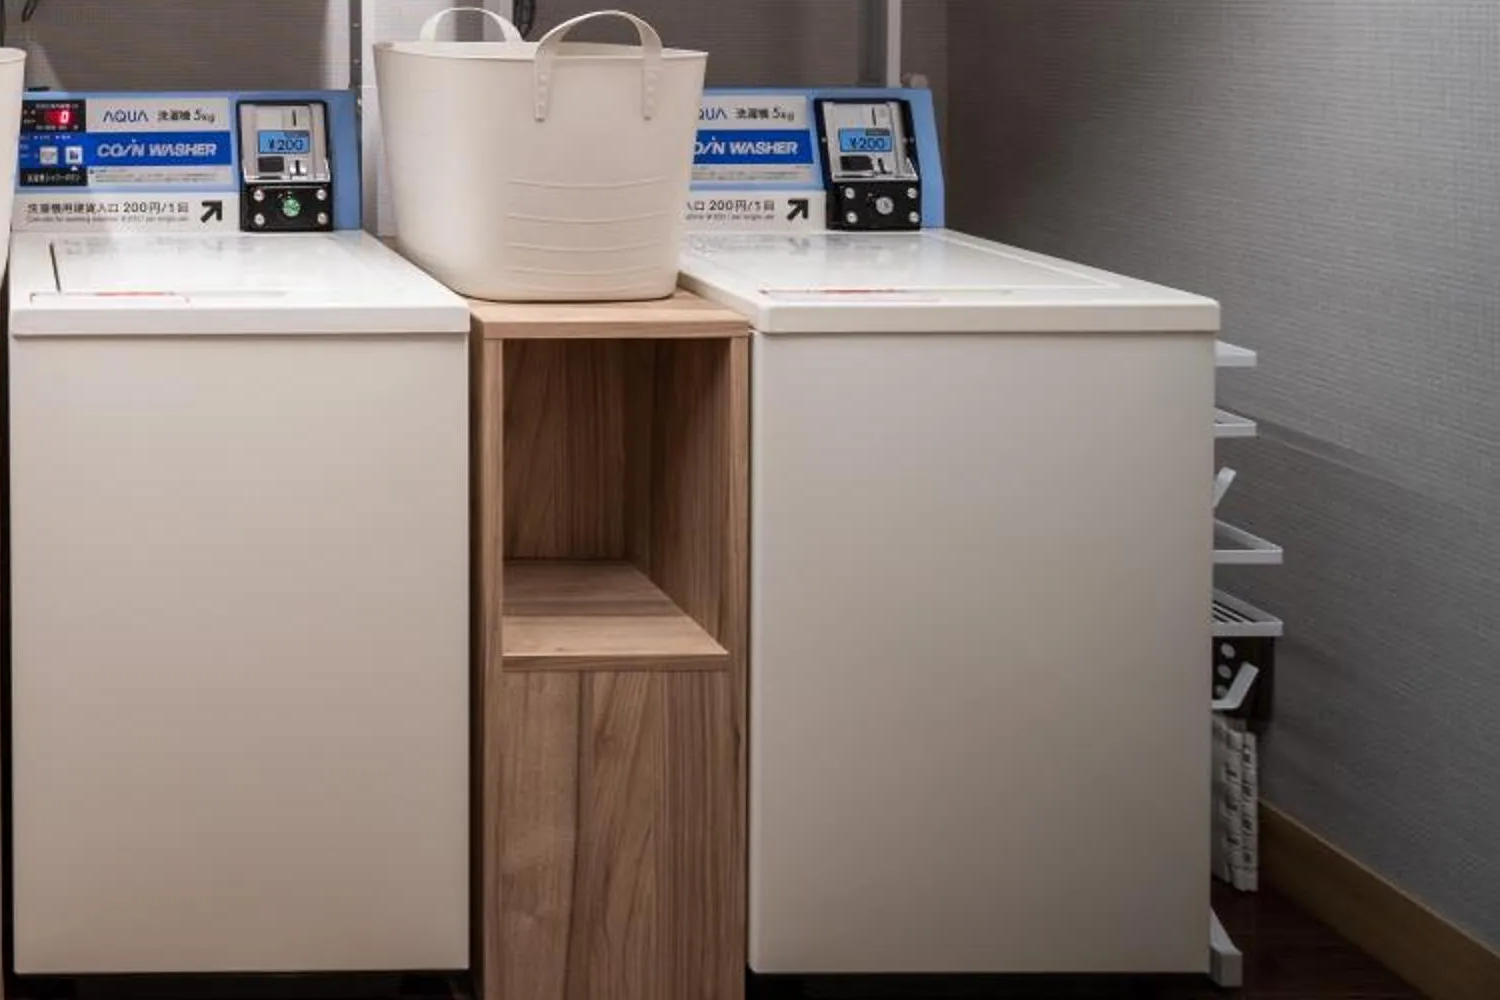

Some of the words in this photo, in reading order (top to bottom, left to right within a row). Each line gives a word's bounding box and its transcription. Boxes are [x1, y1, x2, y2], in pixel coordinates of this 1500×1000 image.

[59, 110, 70, 123] 0
[103, 109, 149, 122] AQUA
[157, 109, 191, 122] 洗濯機
[193, 108, 216, 124] 5kg
[698, 107, 728, 120] QUA
[268, 138, 305, 151] ¥200
[729, 141, 799, 155] WASHER
[849, 136, 886, 149] ¥200
[149, 142, 217, 157] WASHER
